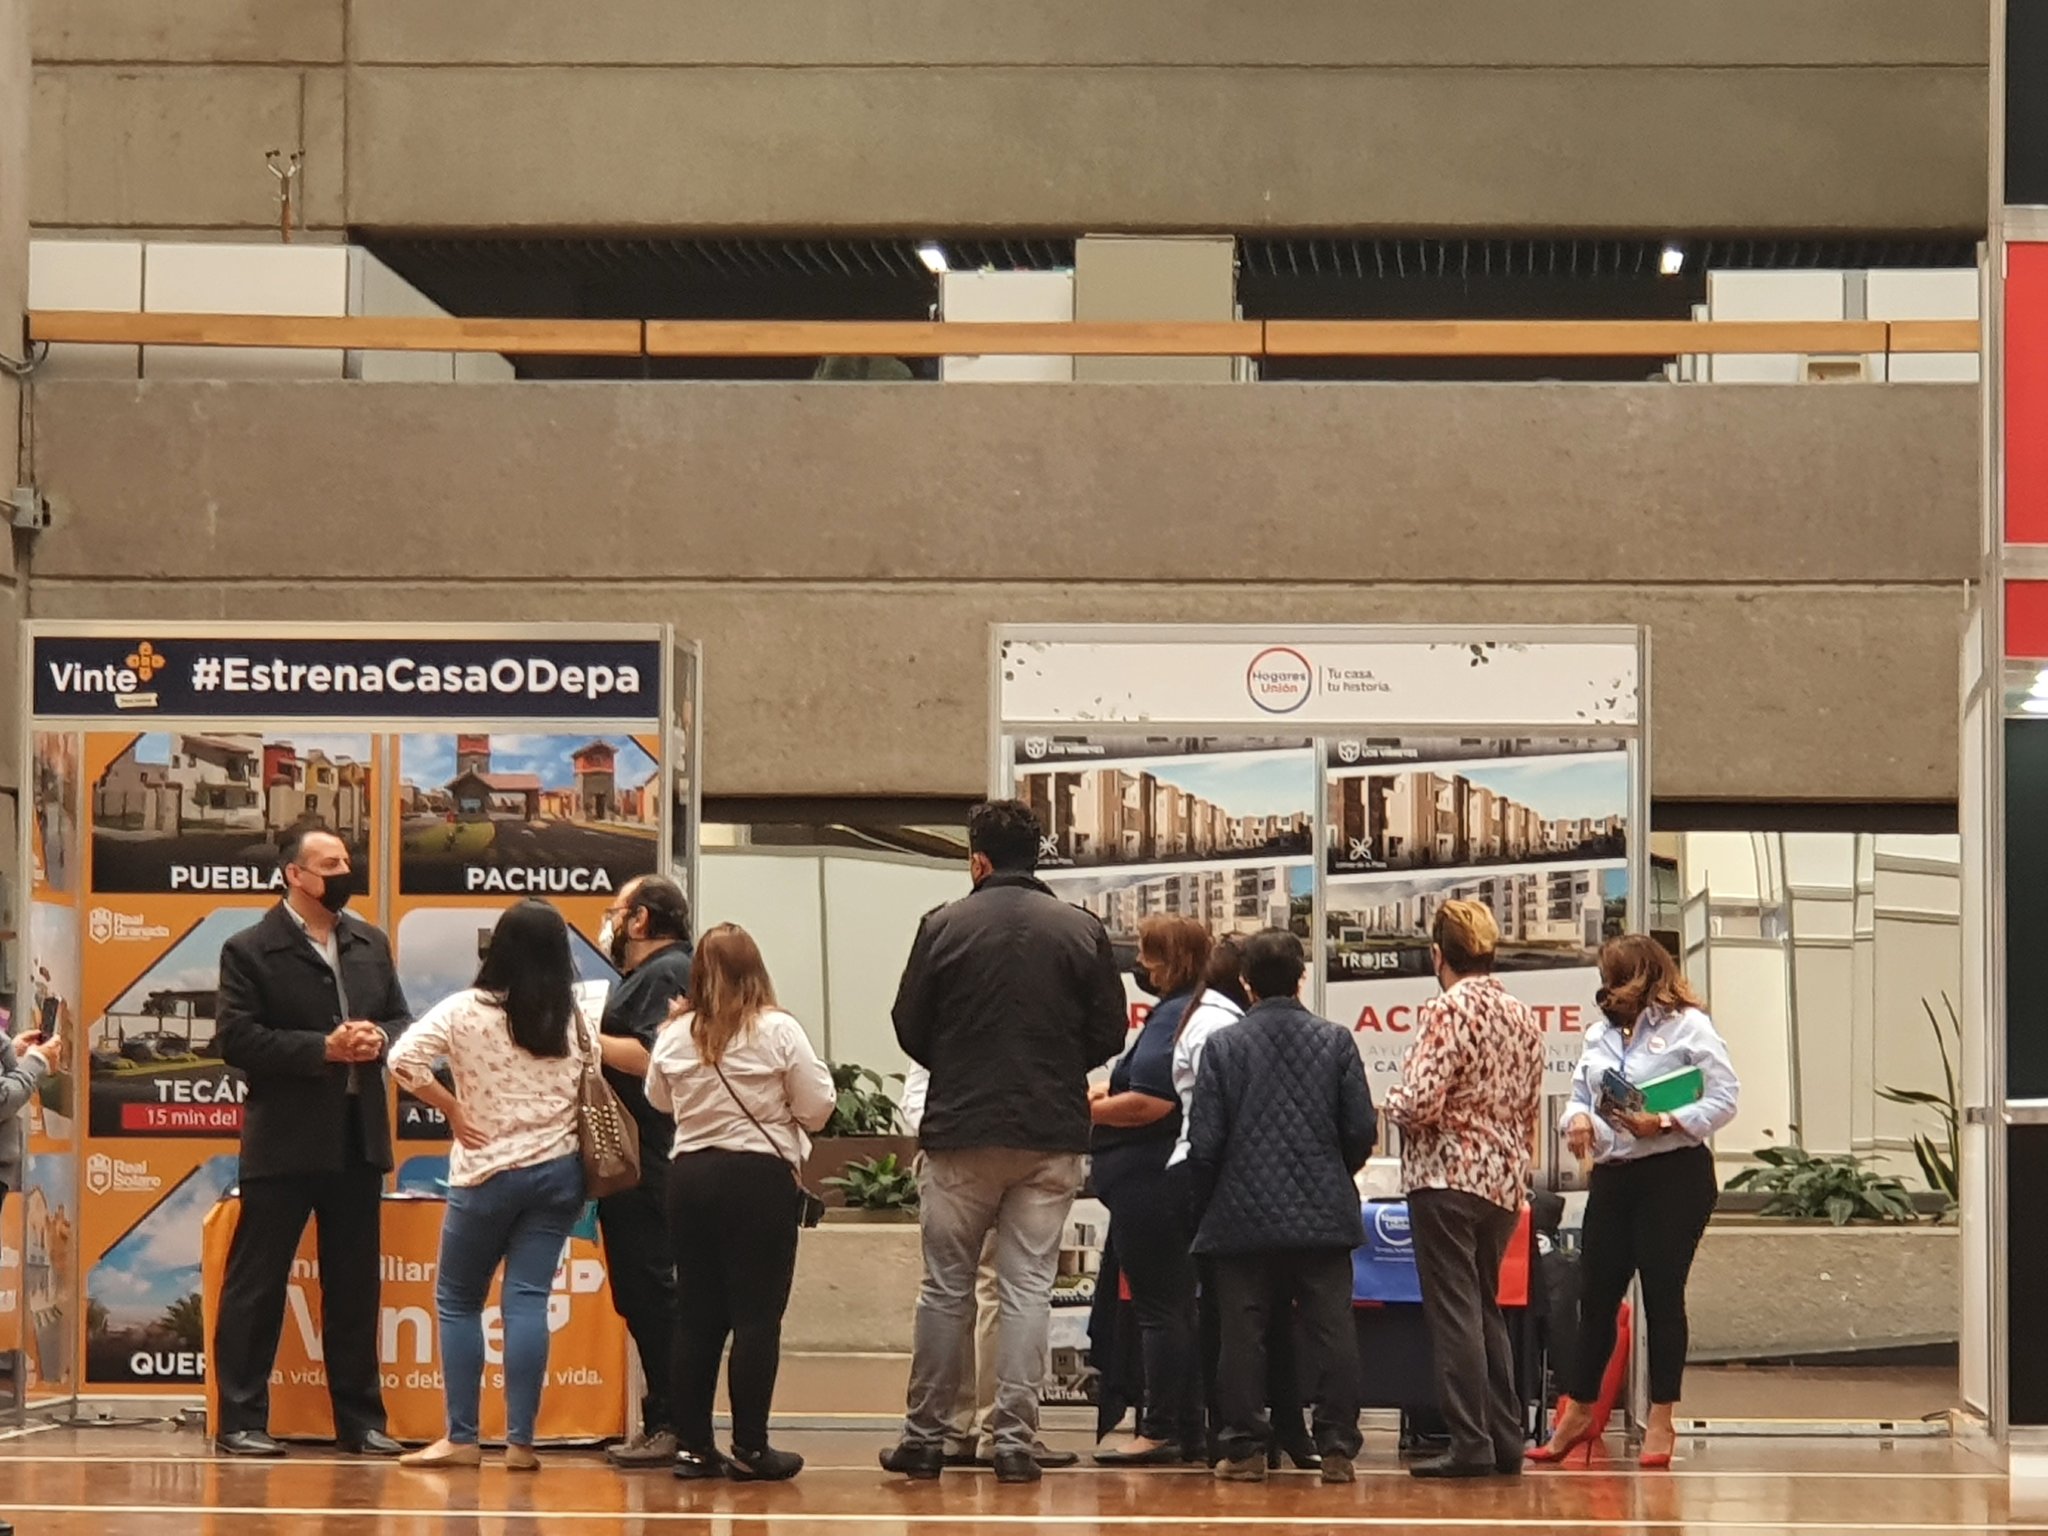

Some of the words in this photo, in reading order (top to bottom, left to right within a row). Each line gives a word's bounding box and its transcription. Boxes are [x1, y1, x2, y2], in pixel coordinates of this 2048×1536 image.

[49, 661, 137, 692] Vinte
[193, 658, 640, 699] #EstrenaCasaODepa
[1253, 671, 1306, 682] Hogares
[1328, 667, 1342, 679] Tu
[1261, 681, 1298, 693] Unión
[1328, 682, 1340, 692] tu
[171, 865, 287, 889] PUEBLA
[467, 867, 613, 891] PACHUCA
[146, 1108, 168, 1125] 15
[171, 1108, 205, 1125] min
[209, 1108, 238, 1125] del
[406, 1107, 421, 1123] A
[556, 1366, 603, 1386] vida.
